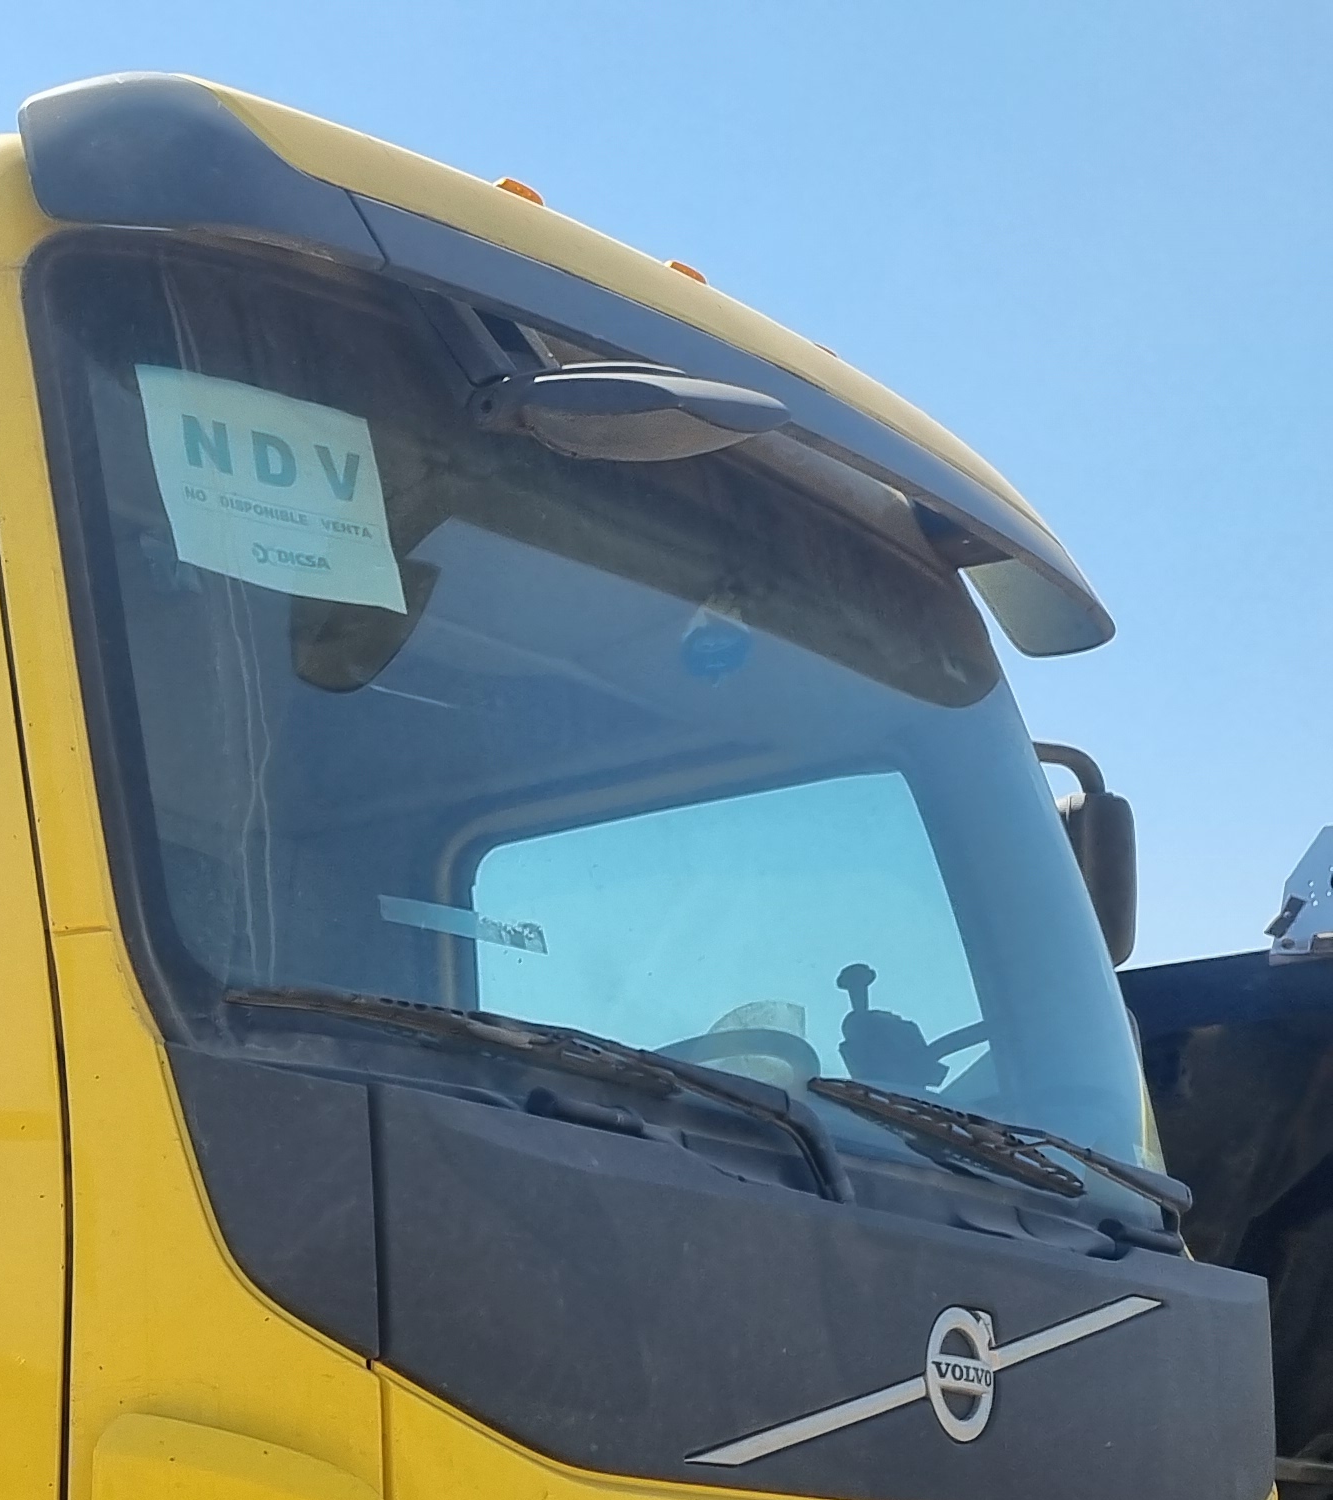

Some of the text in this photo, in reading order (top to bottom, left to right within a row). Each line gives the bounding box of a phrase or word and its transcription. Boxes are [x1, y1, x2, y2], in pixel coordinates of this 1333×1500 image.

[184, 486, 374, 540] NO DISPONIBLE VENTA
[277, 549, 332, 571] DICSA
[932, 1361, 992, 1387] VOLVO
